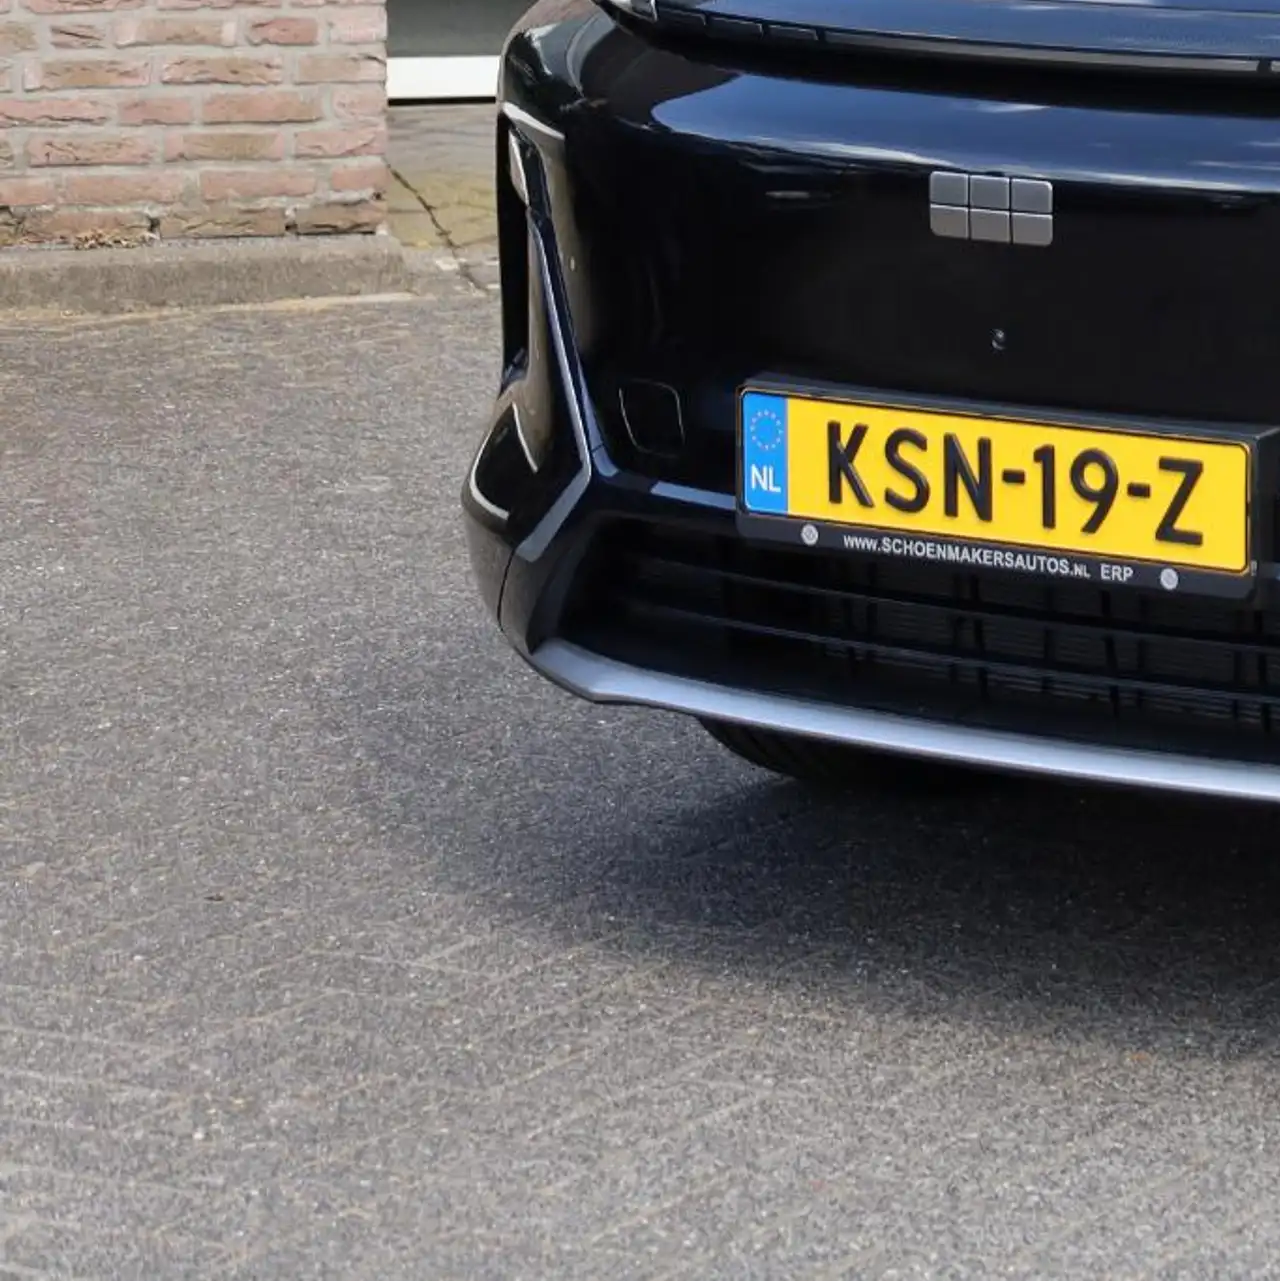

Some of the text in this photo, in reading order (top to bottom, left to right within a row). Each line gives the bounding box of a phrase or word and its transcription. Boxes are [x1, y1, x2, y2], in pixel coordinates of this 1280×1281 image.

[750, 463, 781, 494] NL
[826, 420, 1205, 547] KSN-19-Z
[1100, 563, 1133, 582] ERP
